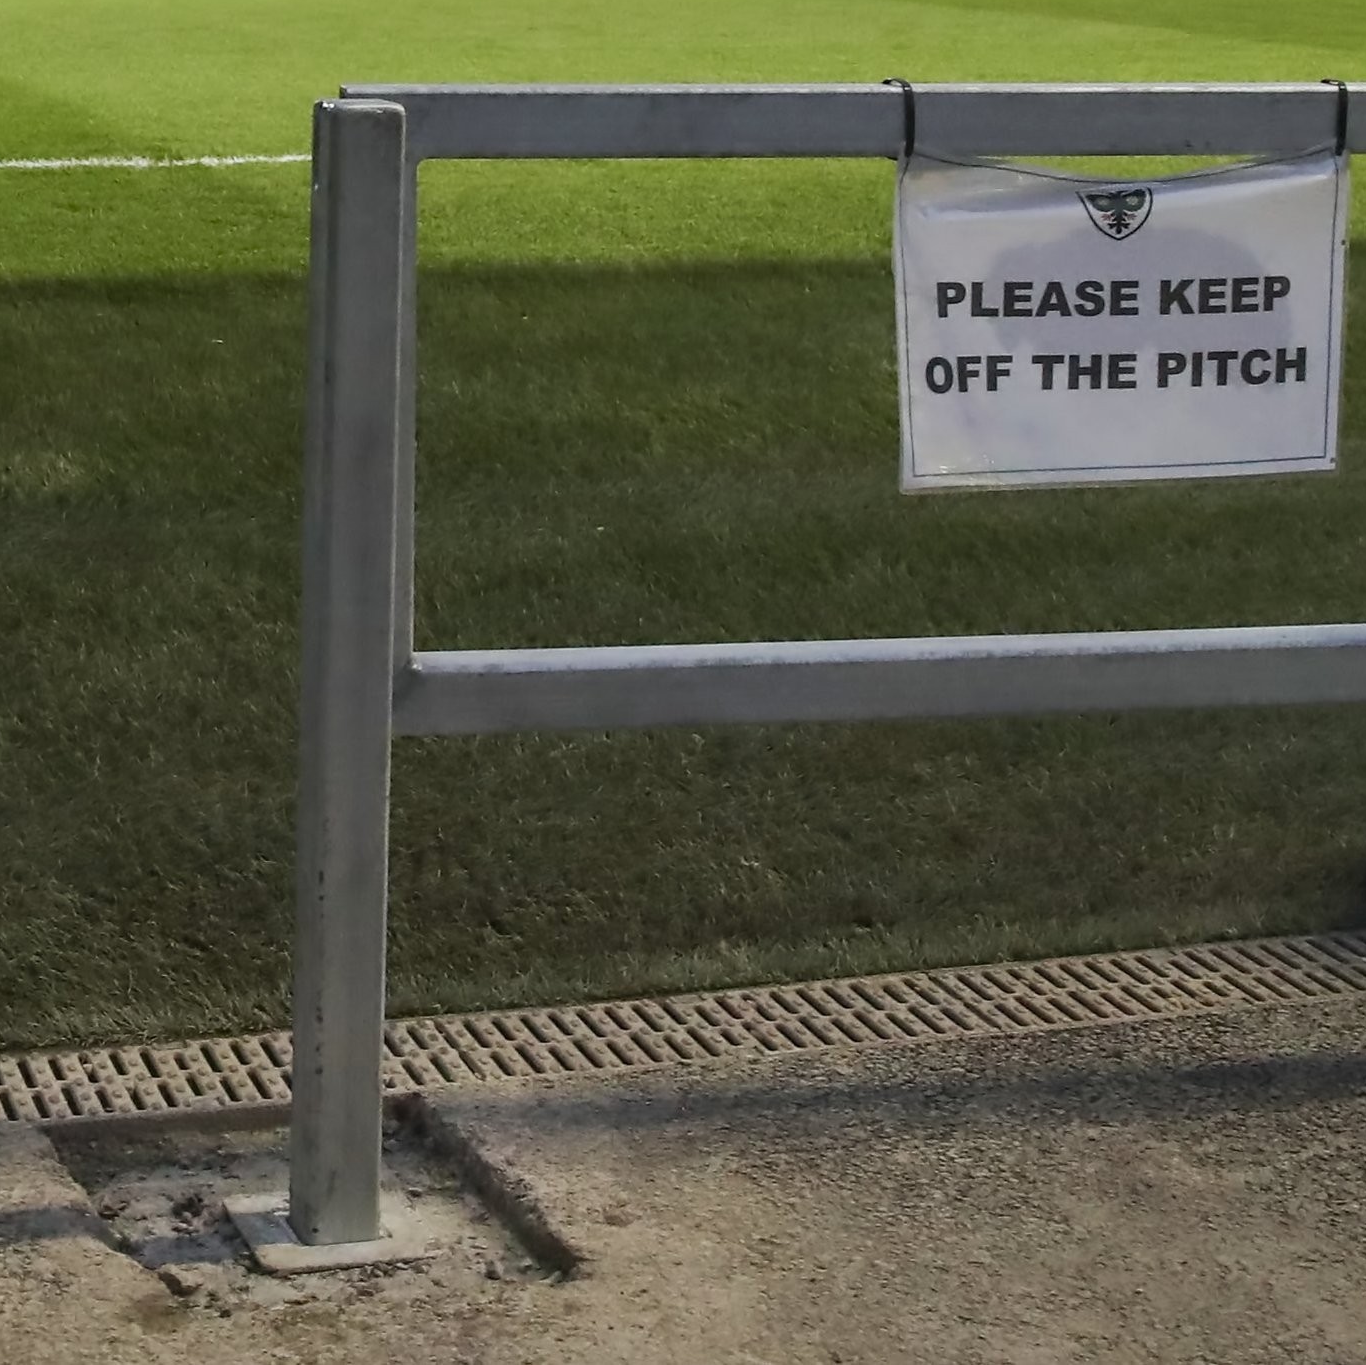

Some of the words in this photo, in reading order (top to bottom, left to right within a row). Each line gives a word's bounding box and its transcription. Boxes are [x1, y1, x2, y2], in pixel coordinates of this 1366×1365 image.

[936, 279, 1140, 319] PLEASE
[1159, 275, 1292, 316] KEEP
[924, 354, 1014, 395] OFF
[1031, 352, 1138, 391] THE
[1156, 346, 1308, 389] PITCH
